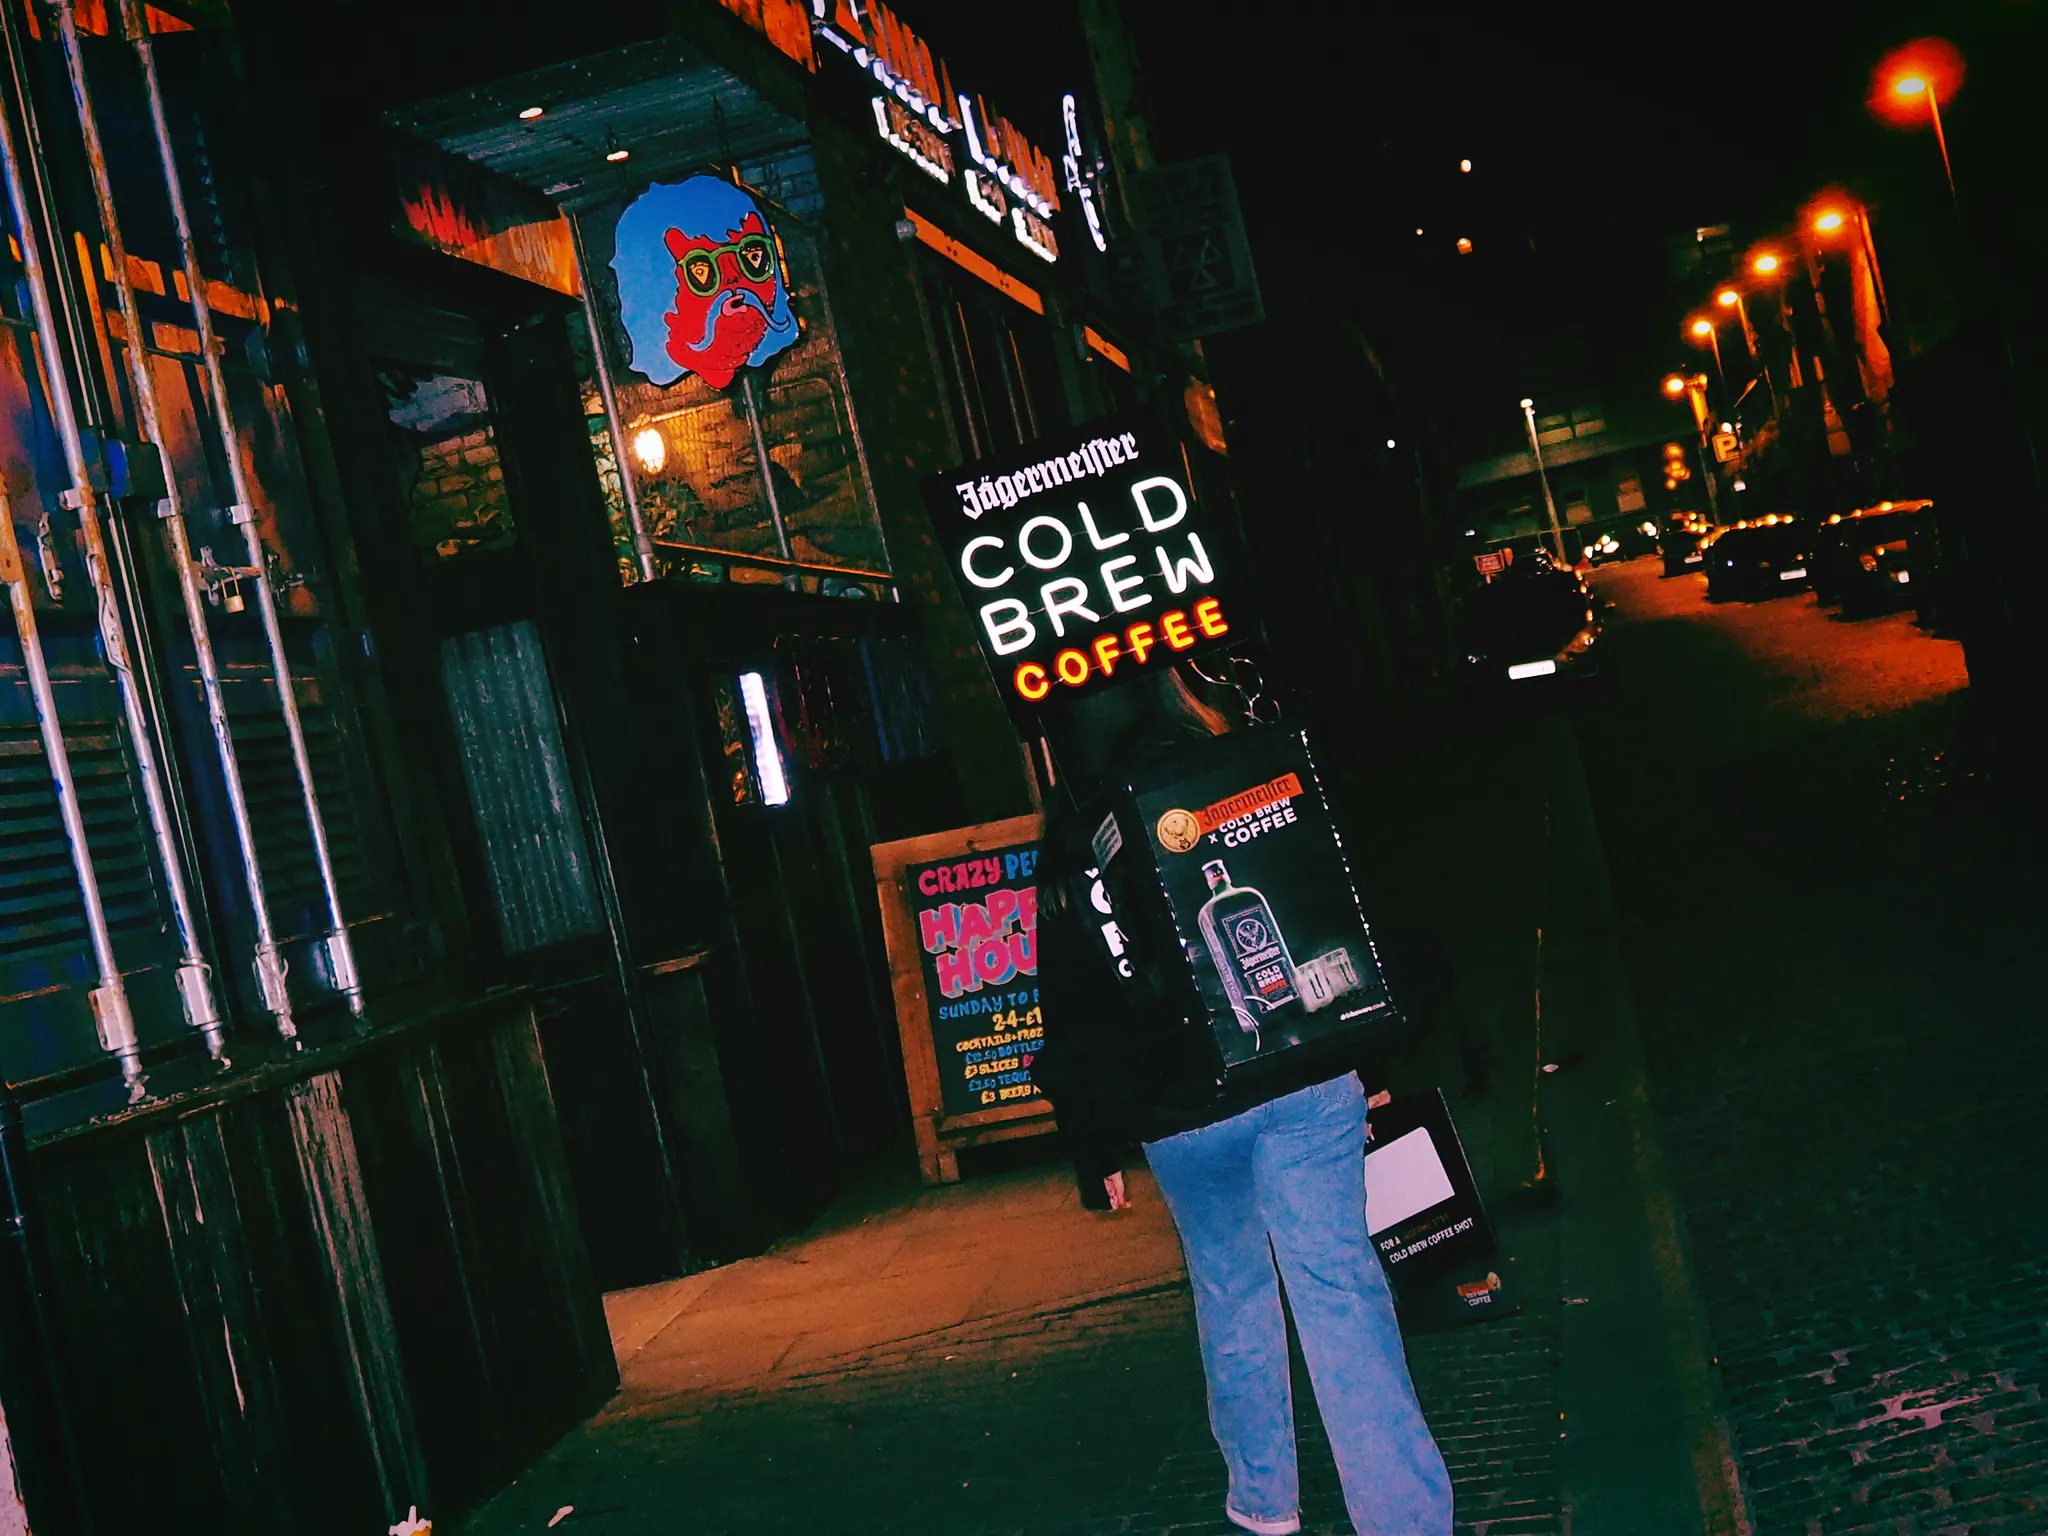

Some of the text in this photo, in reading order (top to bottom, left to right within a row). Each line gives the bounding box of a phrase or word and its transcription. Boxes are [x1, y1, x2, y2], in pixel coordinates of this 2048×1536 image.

[960, 476, 1188, 589] COLD
[979, 532, 1216, 656] BREW
[1014, 597, 1230, 702] COFFEE
[1218, 813, 1253, 834] COLD
[1254, 796, 1292, 820] BREW
[1223, 807, 1298, 849] COFFEE
[918, 856, 1001, 897] CRAZY
[1254, 965, 1281, 981] COLD
[939, 996, 1003, 1020] SUNDAY
[1007, 991, 1028, 1006] TO
[980, 1058, 1020, 1074] SLICES
[1379, 1236, 1402, 1252] FOR A
[1388, 1249, 1409, 1264] COLD
[1407, 1239, 1428, 1256] BREW
[1427, 1226, 1455, 1246] COFFEE
[1453, 1217, 1474, 1234] SHOT
